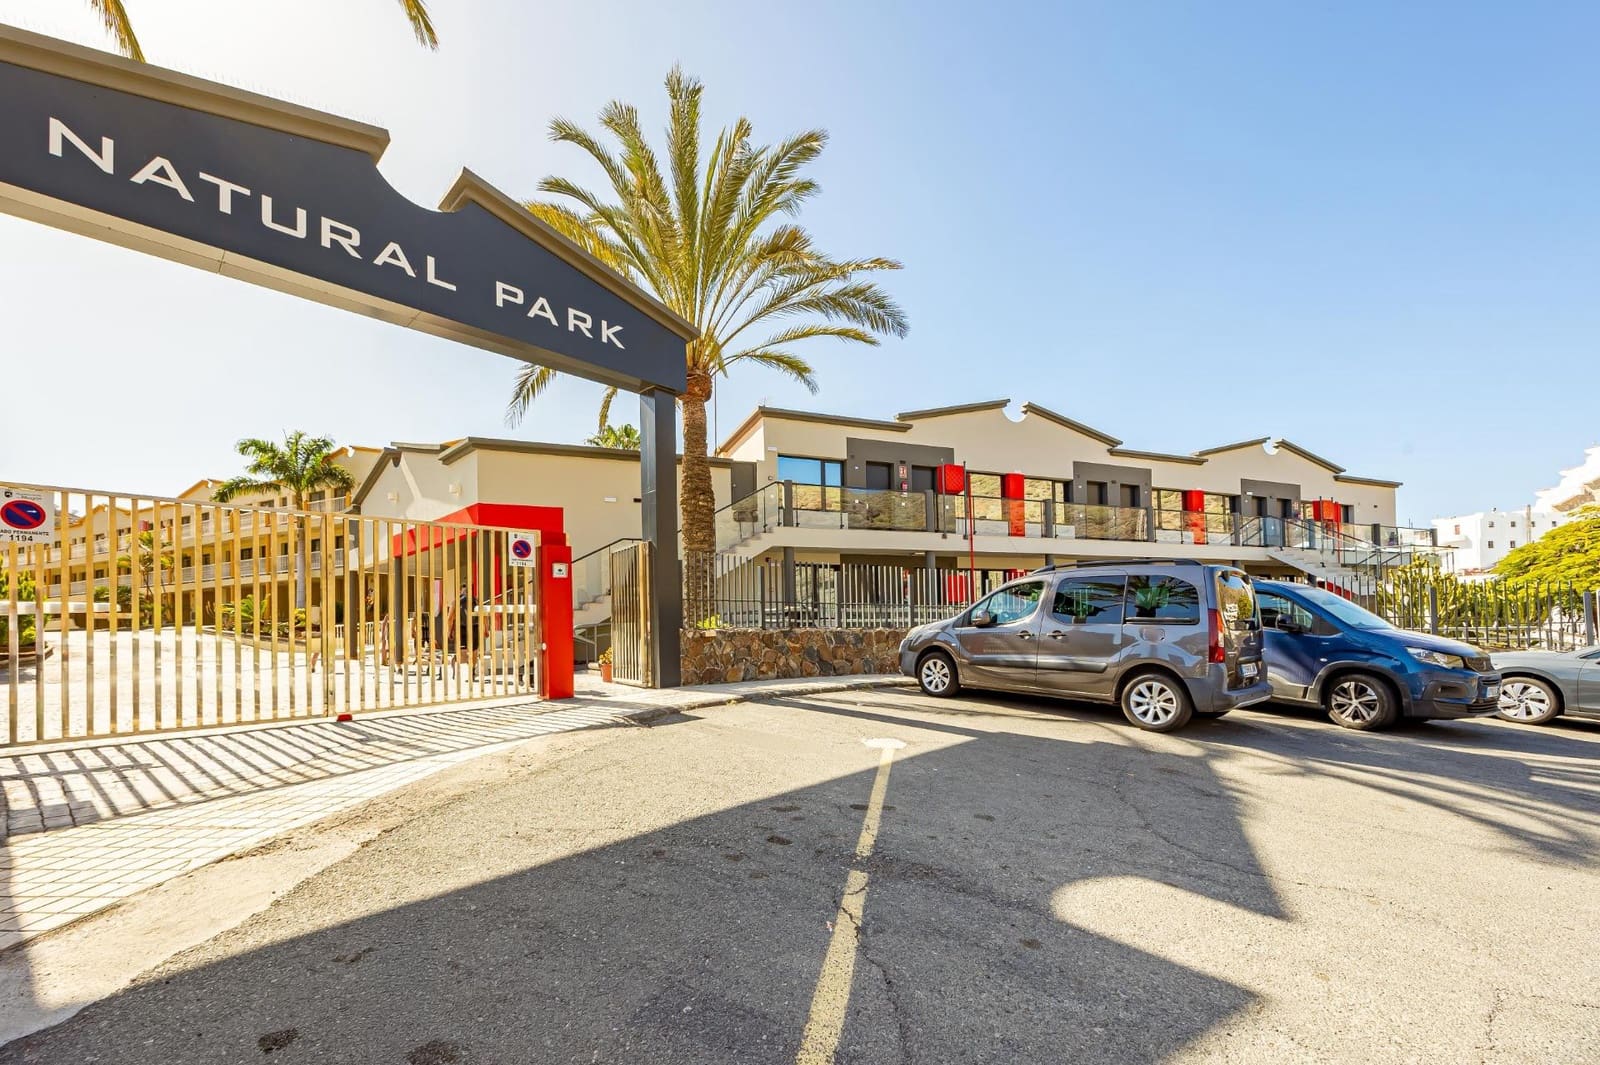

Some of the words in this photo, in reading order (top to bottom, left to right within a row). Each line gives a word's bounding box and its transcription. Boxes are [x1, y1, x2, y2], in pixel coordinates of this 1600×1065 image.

[48, 116, 457, 291] NATURAL
[495, 280, 625, 350] PARK
[9, 534, 33, 542] 1194
